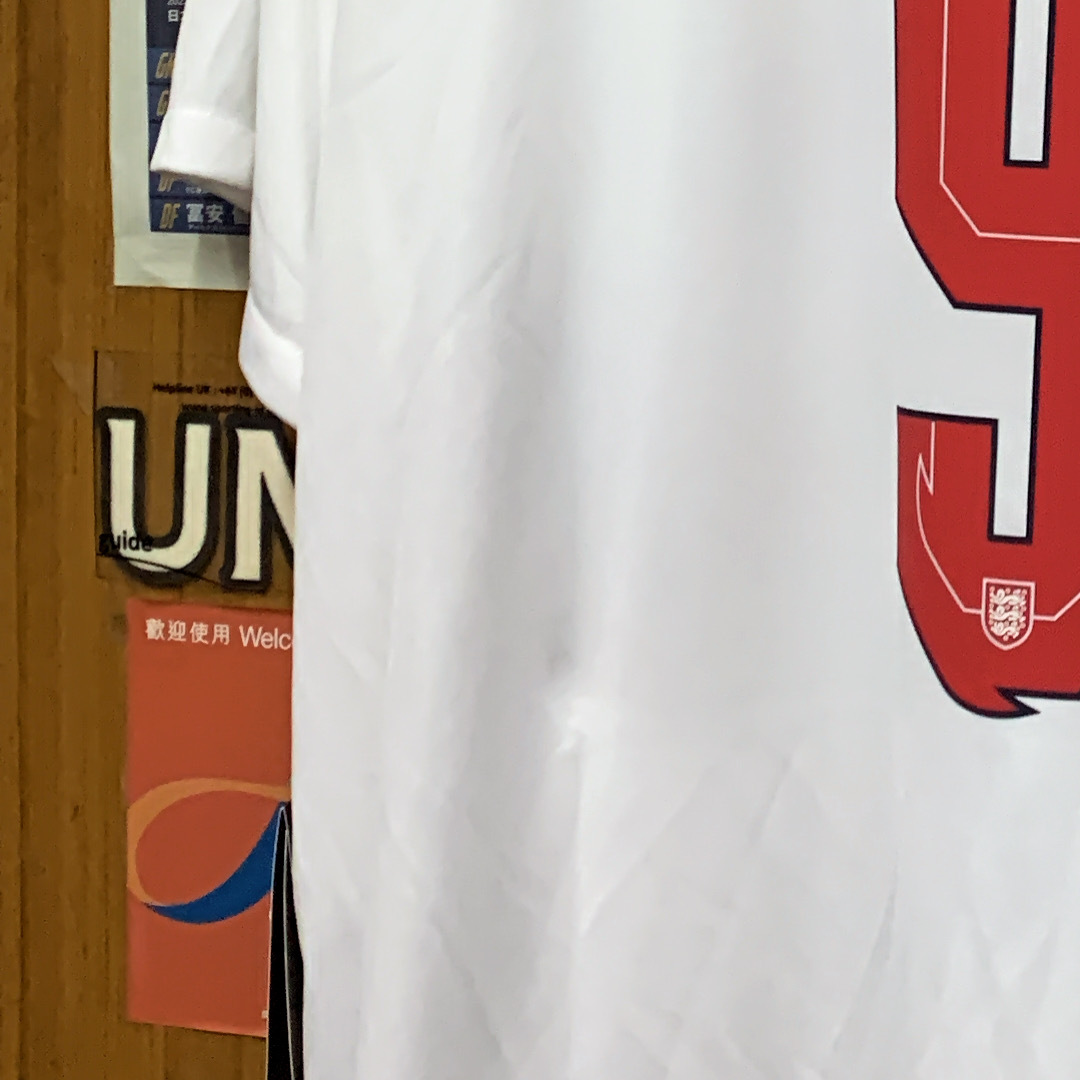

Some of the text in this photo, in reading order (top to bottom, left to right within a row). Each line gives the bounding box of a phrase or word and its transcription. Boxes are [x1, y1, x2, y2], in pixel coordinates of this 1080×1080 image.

[98, 530, 154, 555] guide
[145, 617, 231, 646] 歡迎使用
